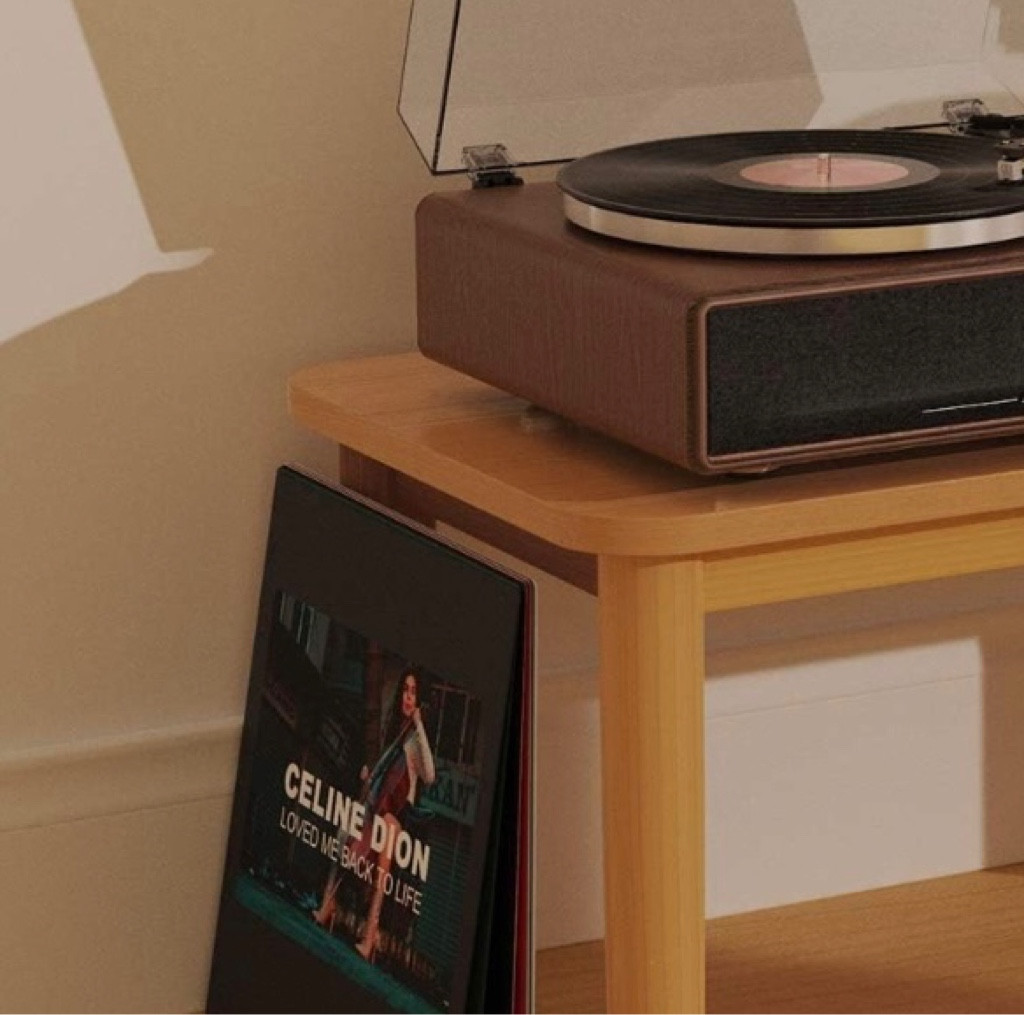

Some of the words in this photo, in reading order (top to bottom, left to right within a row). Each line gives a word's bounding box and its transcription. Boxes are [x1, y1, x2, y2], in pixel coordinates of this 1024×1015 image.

[280, 805, 318, 849] LOVED
[320, 831, 340, 862] ME
[341, 845, 375, 885] BACK
[377, 866, 394, 896] TO
[394, 879, 423, 916] LIFE
[285, 763, 366, 842] CELINE
[370, 814, 430, 883] DION
